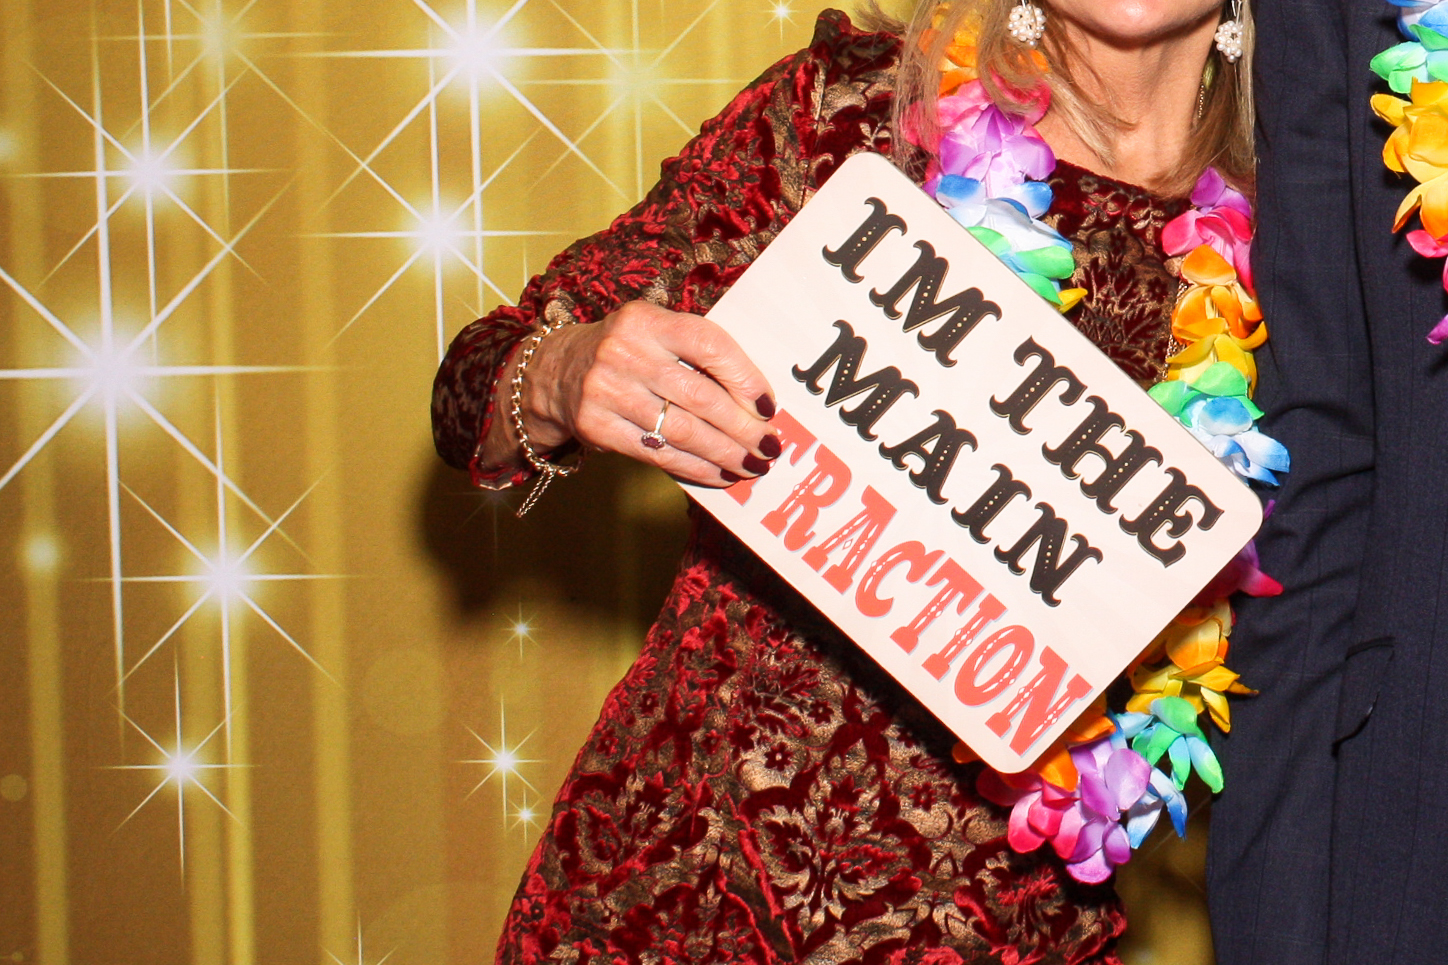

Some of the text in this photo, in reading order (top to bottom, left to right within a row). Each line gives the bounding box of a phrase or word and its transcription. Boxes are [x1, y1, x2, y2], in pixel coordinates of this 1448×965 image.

[790, 319, 1104, 608] MAIN
[822, 197, 1226, 568] IM THE
[724, 408, 1093, 757] TRACTION
